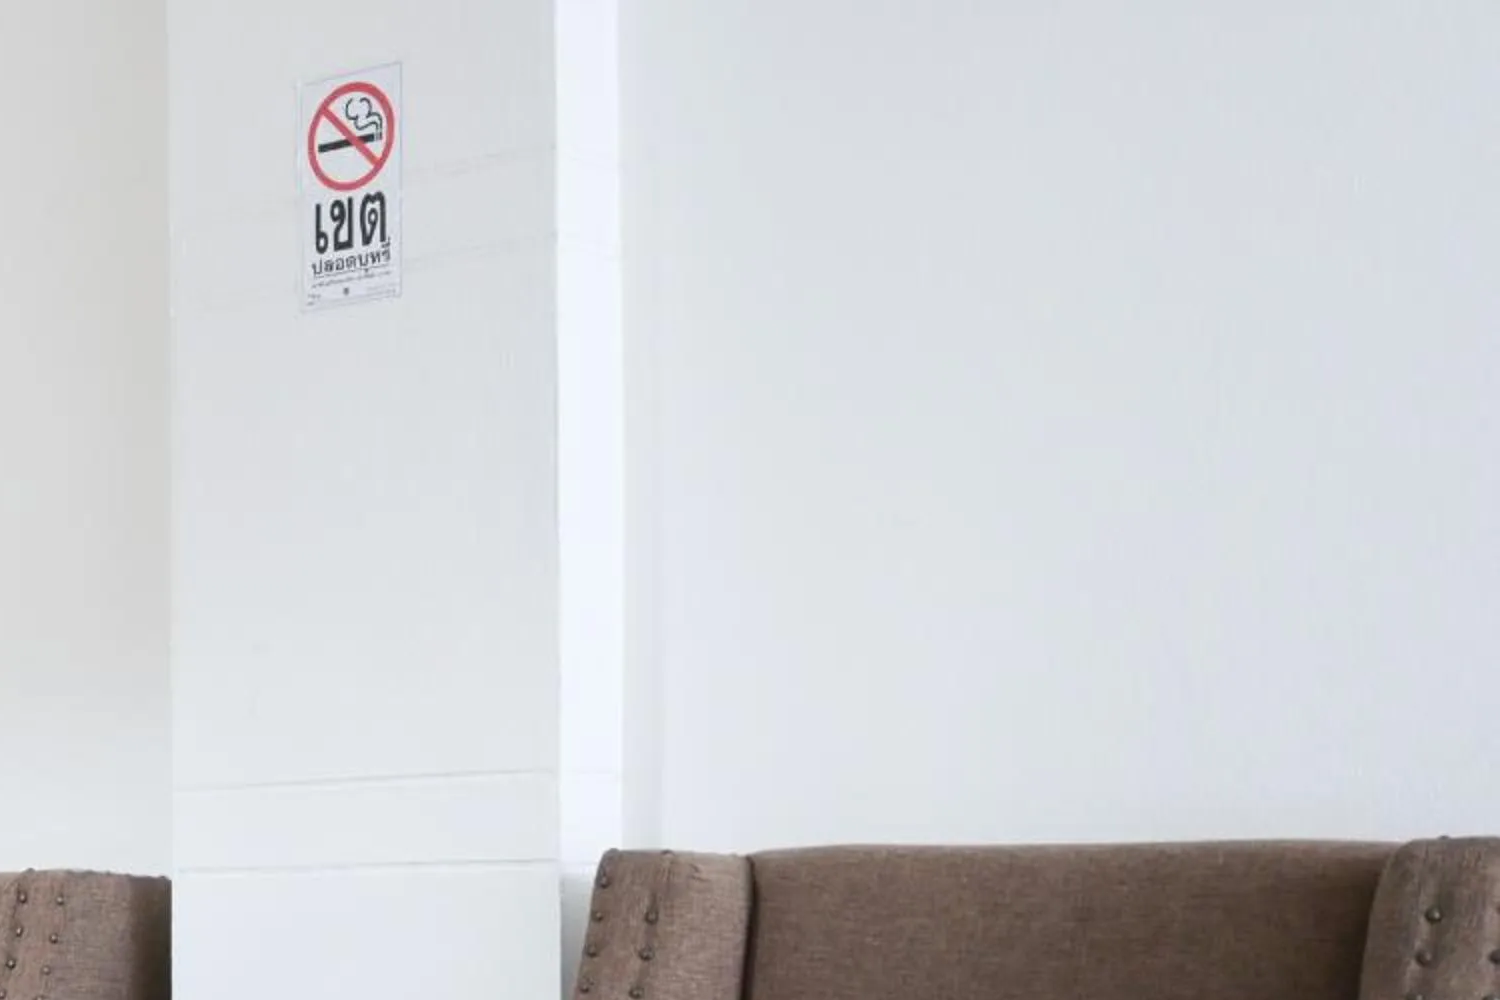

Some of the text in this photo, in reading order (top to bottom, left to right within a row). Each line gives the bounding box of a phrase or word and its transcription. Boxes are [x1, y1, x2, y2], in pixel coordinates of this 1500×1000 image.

[314, 190, 387, 254] เขต
[311, 237, 391, 275] ปลอดบุหรี่
